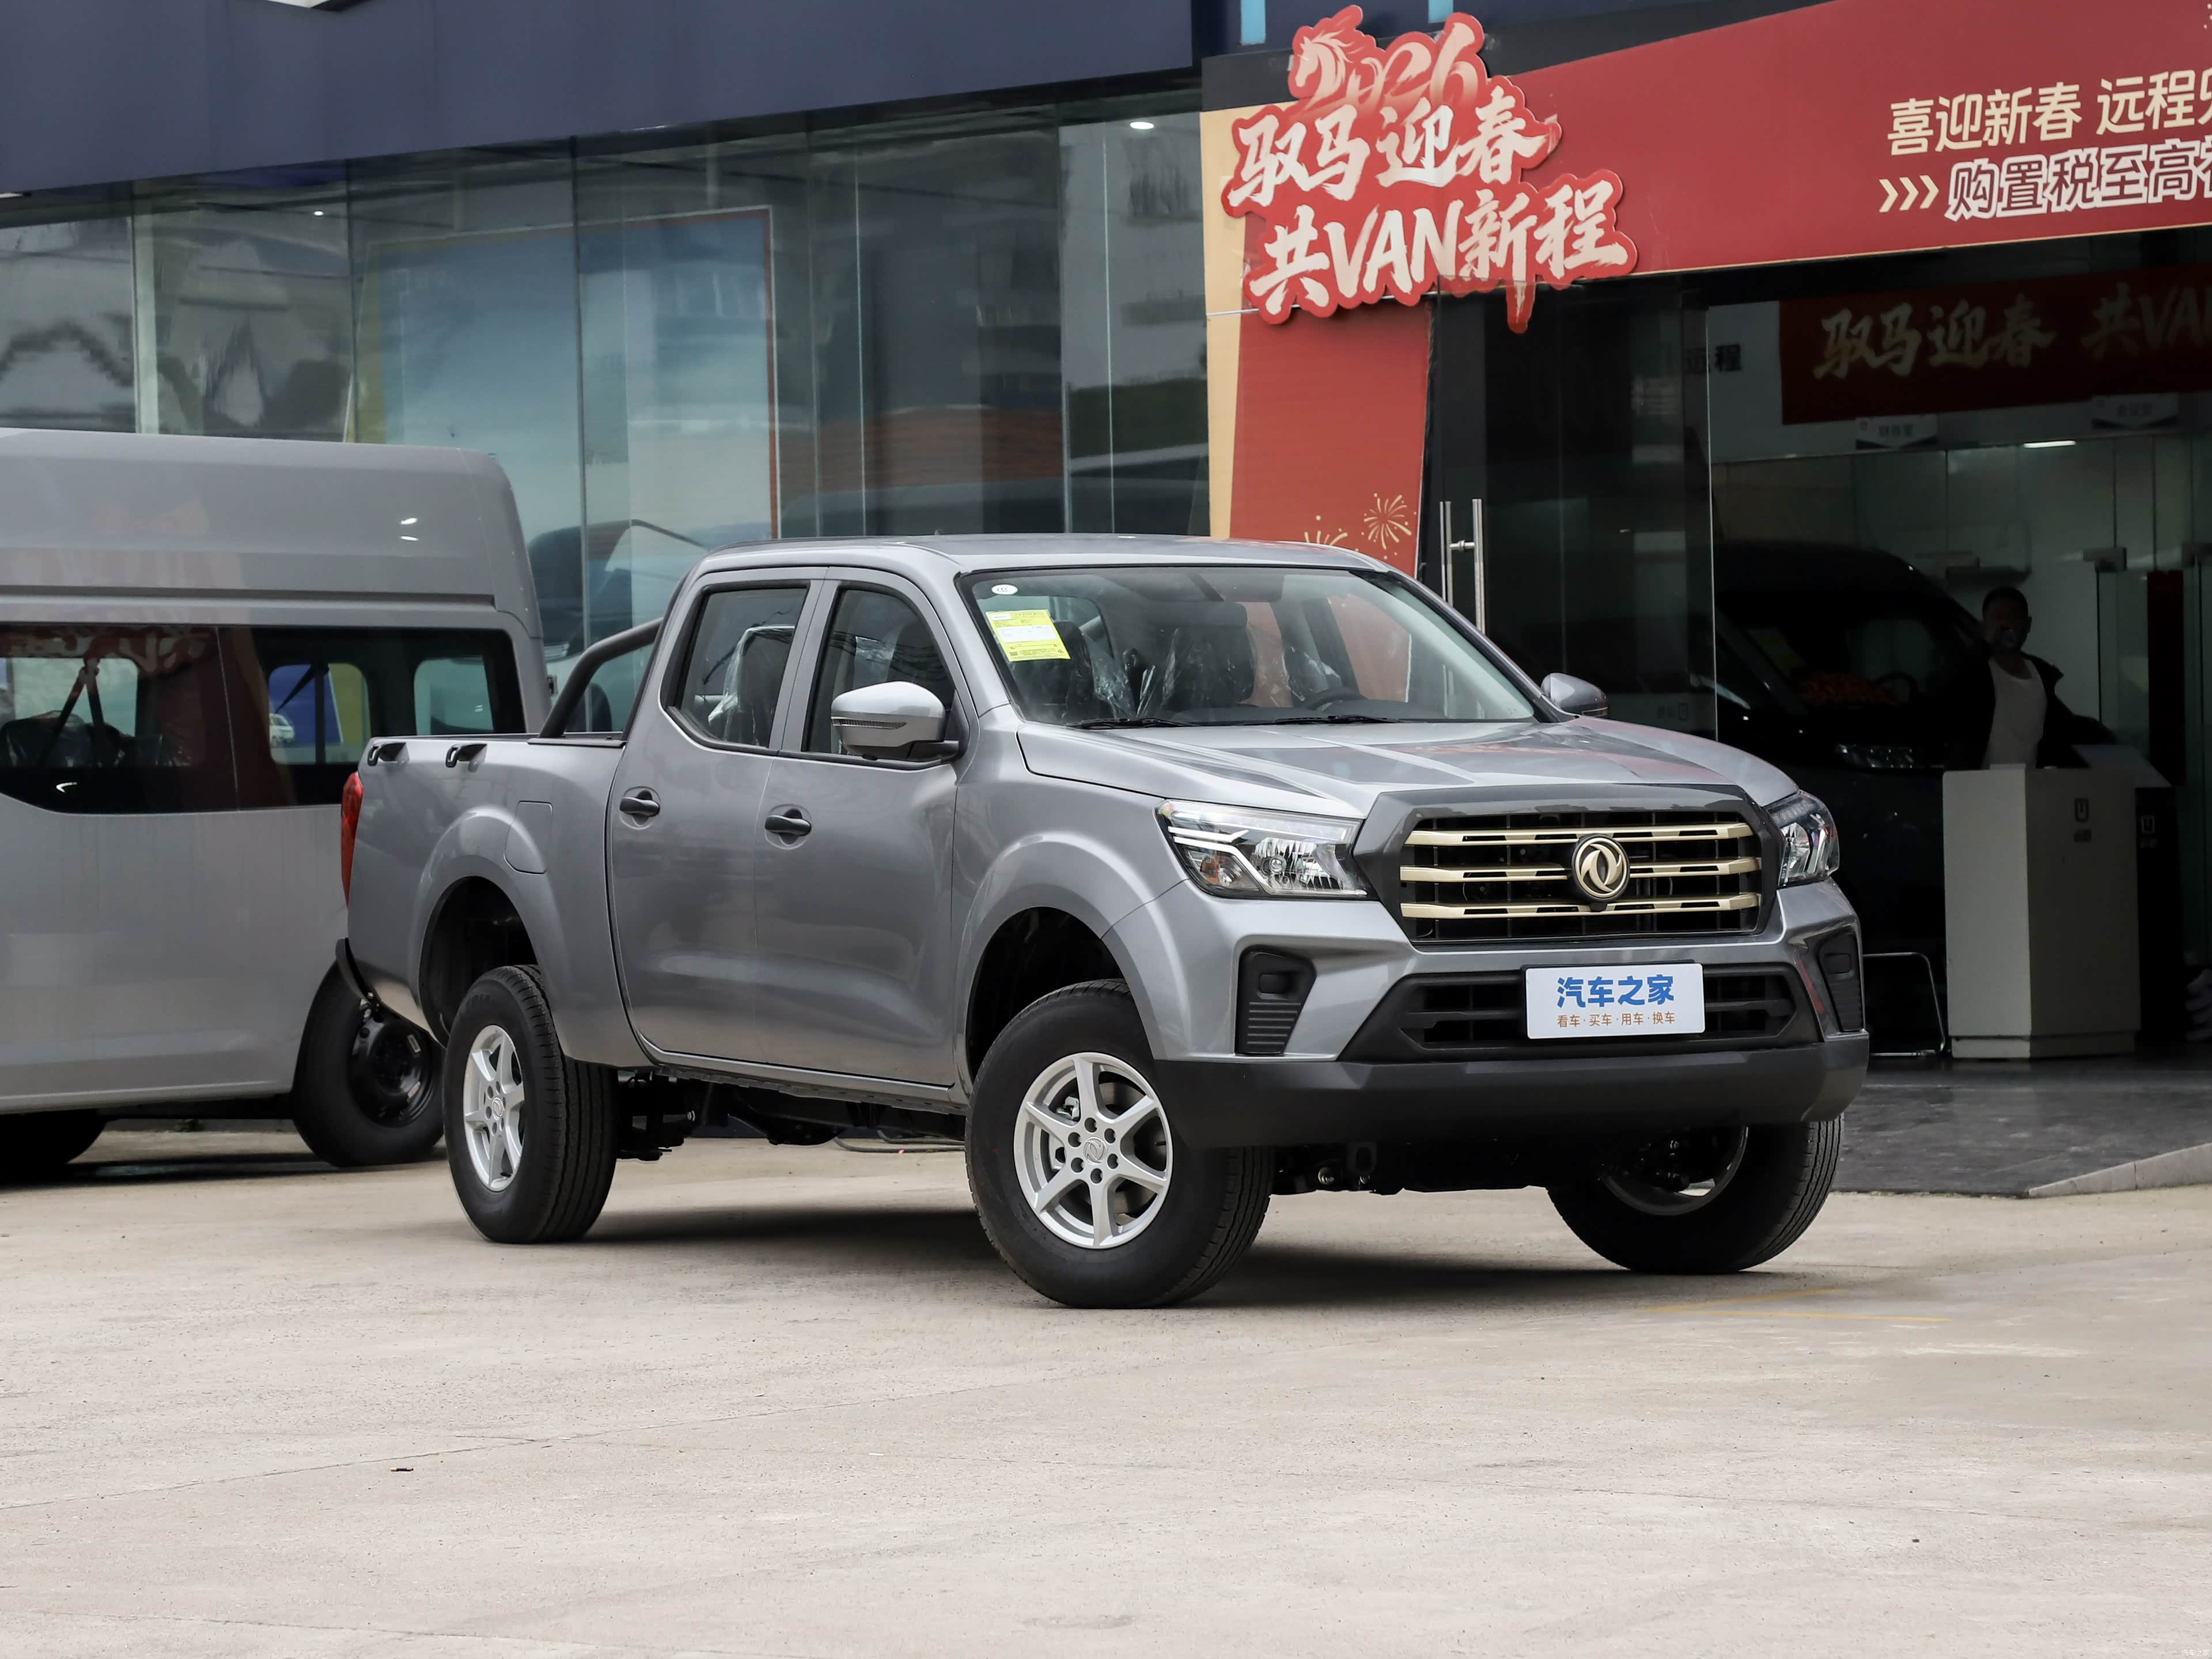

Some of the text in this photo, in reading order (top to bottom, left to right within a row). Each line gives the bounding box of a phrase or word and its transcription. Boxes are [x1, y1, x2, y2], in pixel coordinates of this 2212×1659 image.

[1228, 86, 1546, 207] 驭马迎春
[1888, 81, 2082, 156] 喜迎新春
[1249, 180, 1629, 324] 共VAN新程
[1813, 282, 2212, 379] 驭马迎春 共VA
[1556, 974, 1675, 1009] 汽车之家
